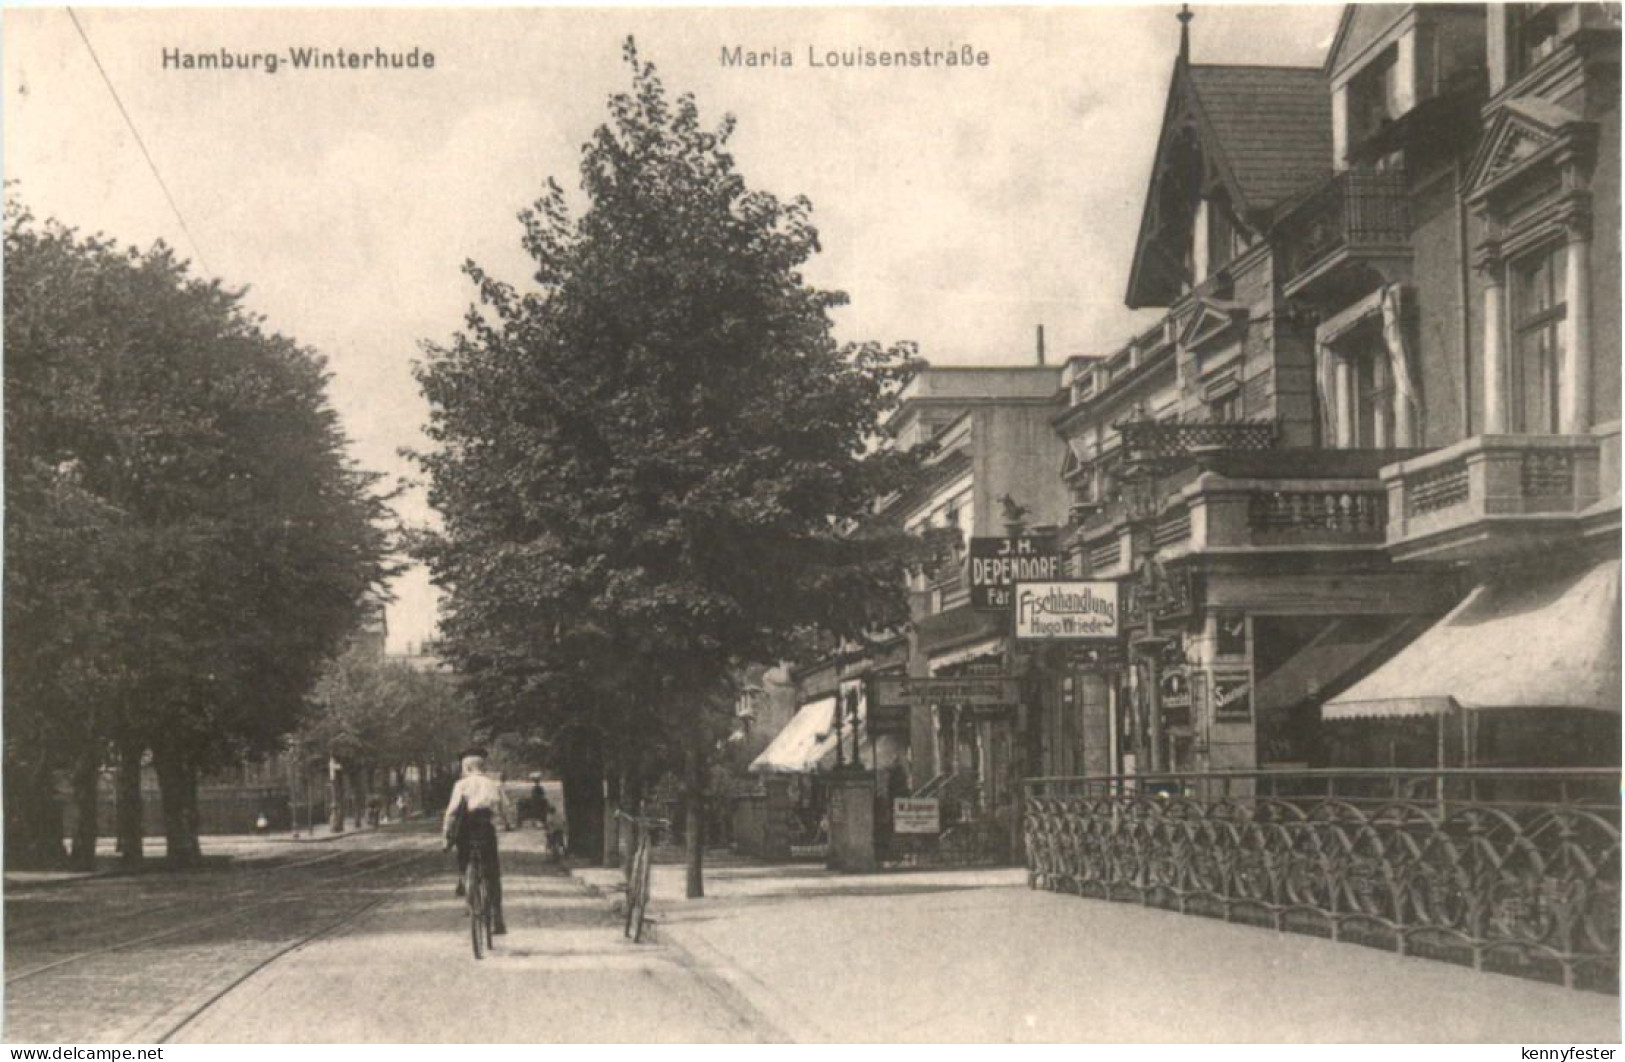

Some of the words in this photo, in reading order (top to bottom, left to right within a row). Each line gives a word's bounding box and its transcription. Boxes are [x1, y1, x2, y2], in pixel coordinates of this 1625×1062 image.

[972, 556, 1058, 586] DEPENDORF
[1019, 586, 1116, 628] Fischhandlung
[1030, 616, 1062, 637] Hugo
